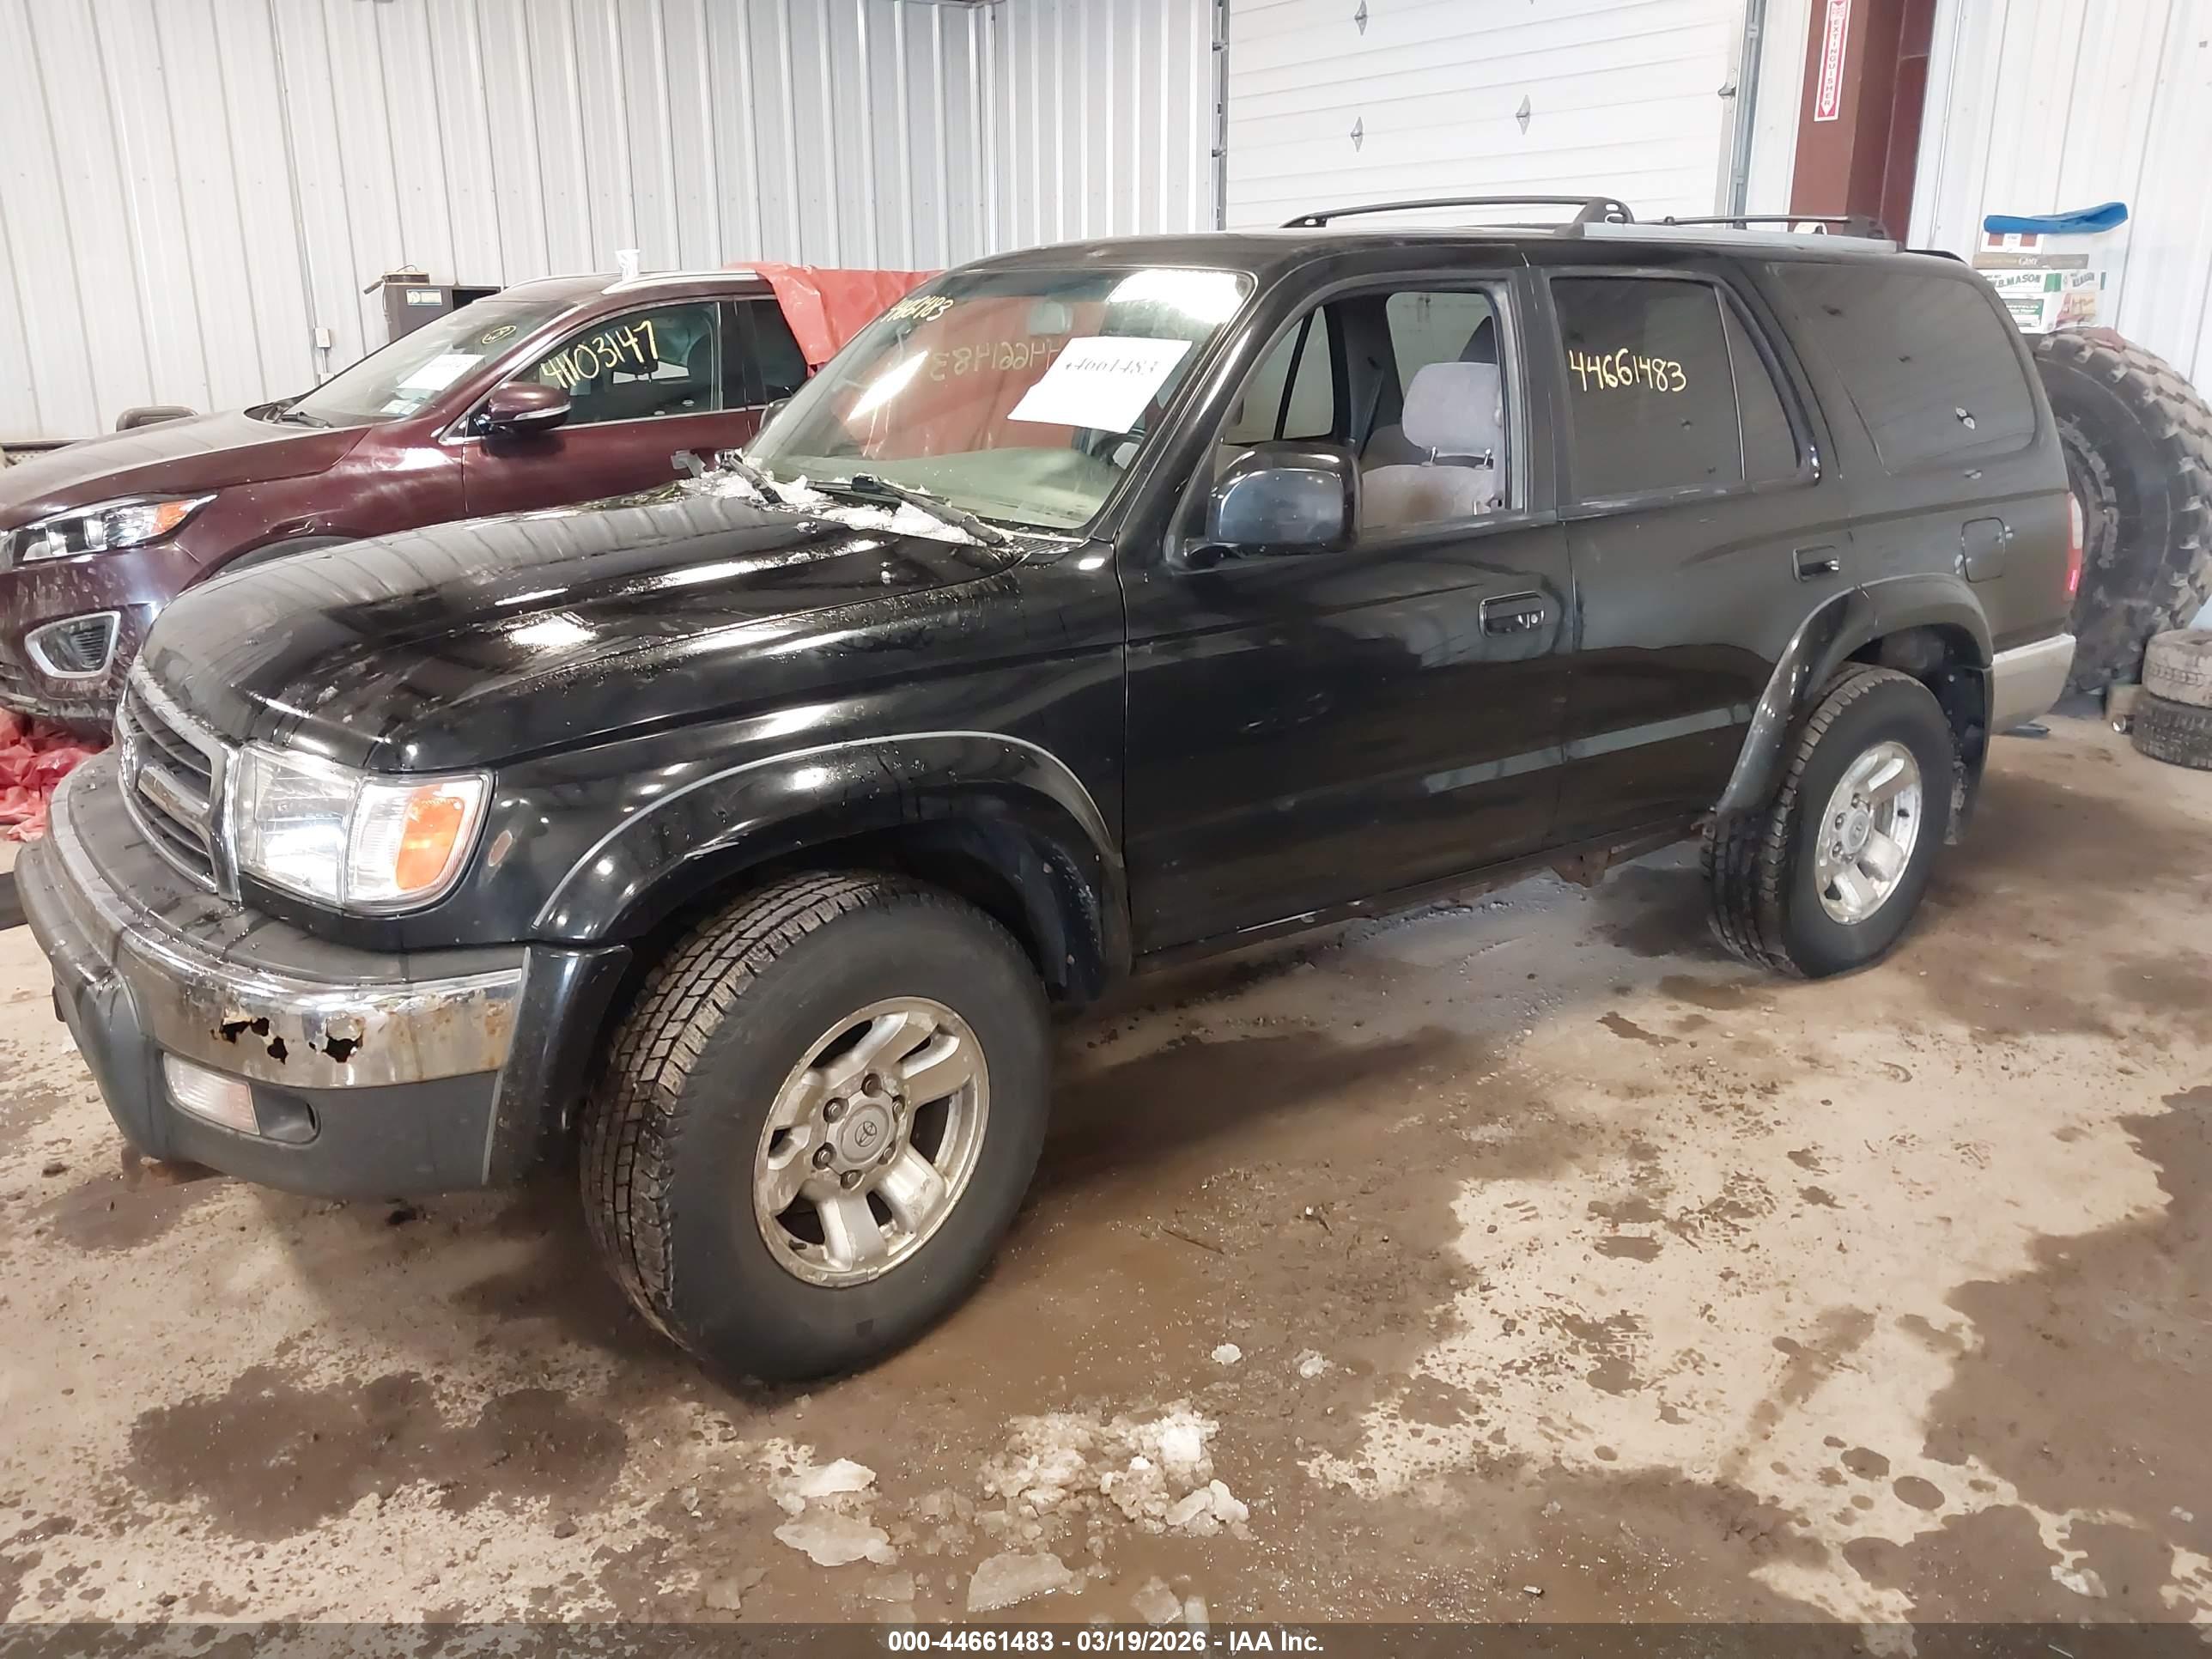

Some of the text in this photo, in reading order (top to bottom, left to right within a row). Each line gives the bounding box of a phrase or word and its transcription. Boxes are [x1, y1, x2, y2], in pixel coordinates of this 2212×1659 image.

[1825, 20, 1838, 106] EXTINGUISHER
[540, 319, 659, 389] 41103147
[1569, 348, 1687, 392] 44661483
